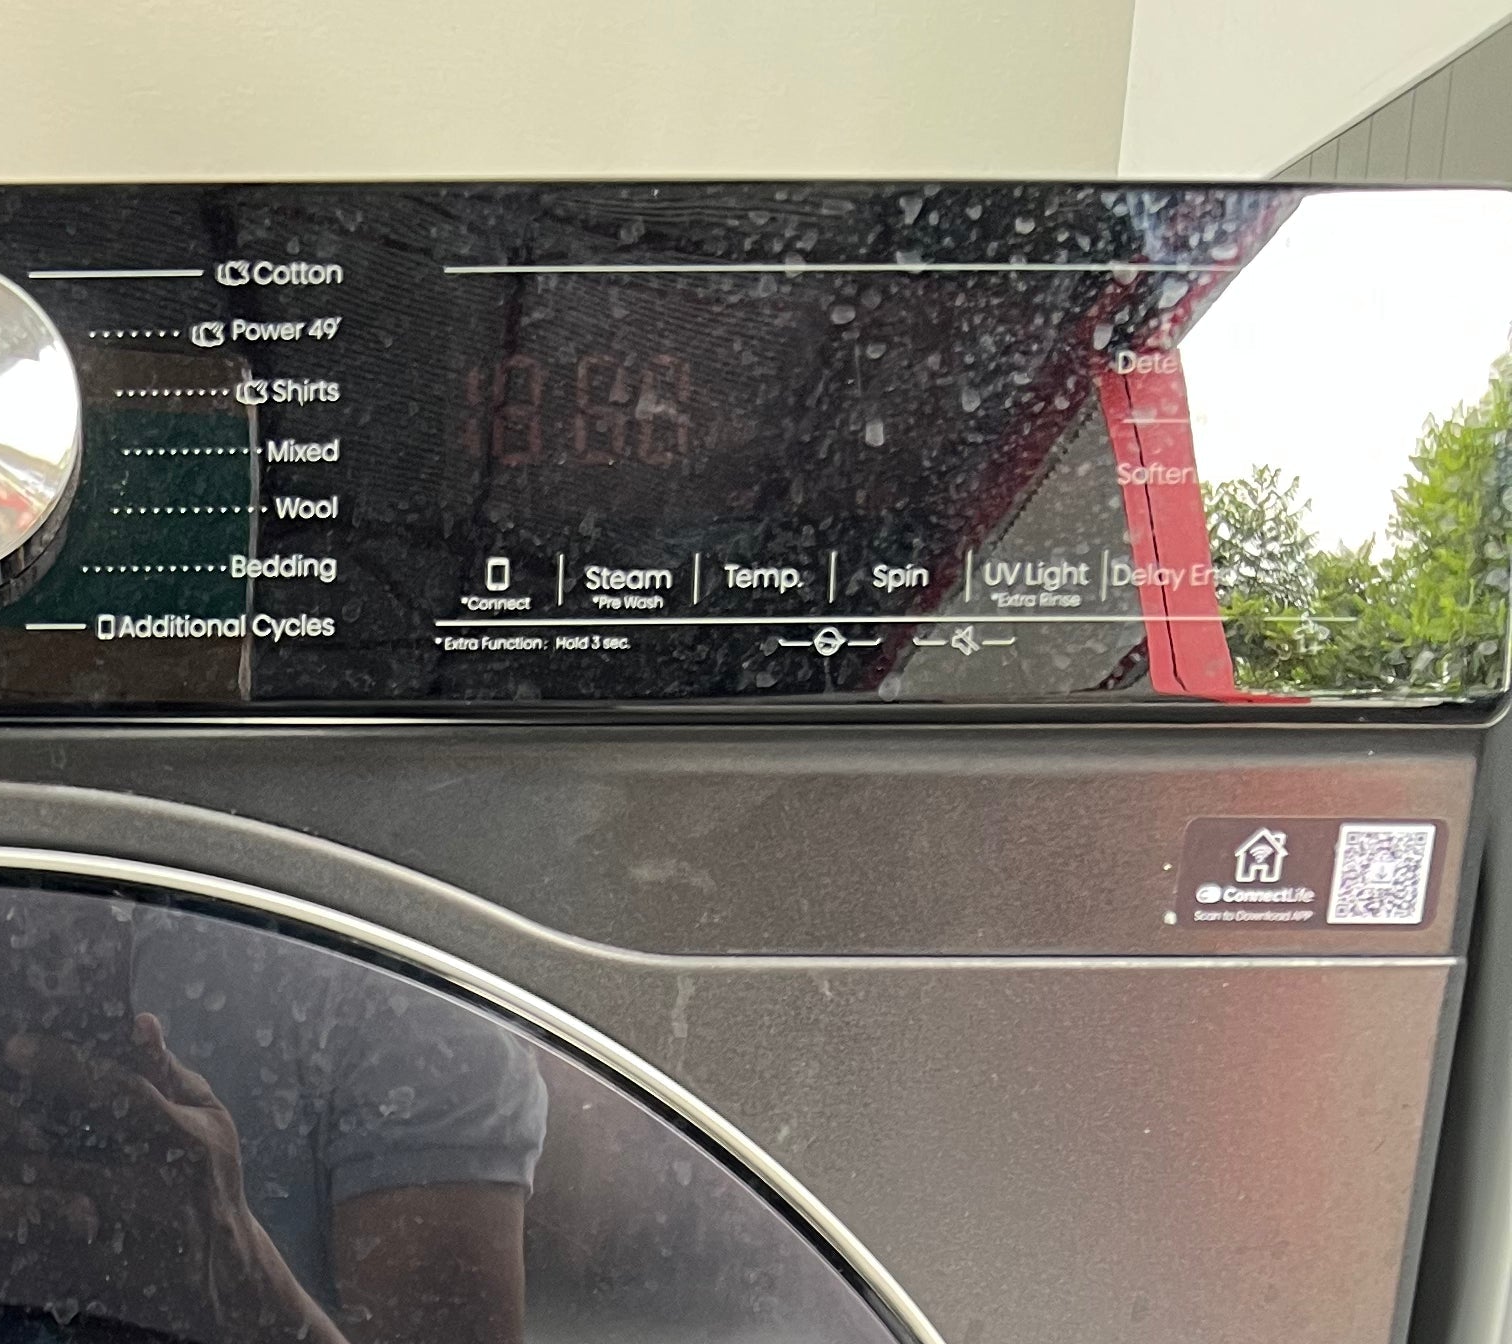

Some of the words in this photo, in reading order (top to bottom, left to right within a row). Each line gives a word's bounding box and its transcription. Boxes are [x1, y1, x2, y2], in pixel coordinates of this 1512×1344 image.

[253, 262, 343, 286] Cotton
[231, 319, 304, 341] Power
[271, 378, 340, 406] Shirts
[267, 439, 339, 463] Mixed
[274, 496, 338, 520] Wool
[230, 554, 338, 583] Bedding
[585, 565, 673, 590] Steam
[723, 564, 805, 595] Temp.
[872, 563, 930, 594] Spin
[983, 561, 1021, 587] UV
[1025, 561, 1090, 591] Light
[1111, 563, 1186, 592] Delay
[624, 595, 664, 610] Wash
[118, 614, 246, 639] Additional
[252, 614, 335, 642] Cycles
[481, 636, 548, 651] Function:
[555, 635, 589, 650] Hold
[591, 634, 601, 649] 3
[603, 636, 631, 650] sec.
[1223, 886, 1315, 902] ConnectLife
